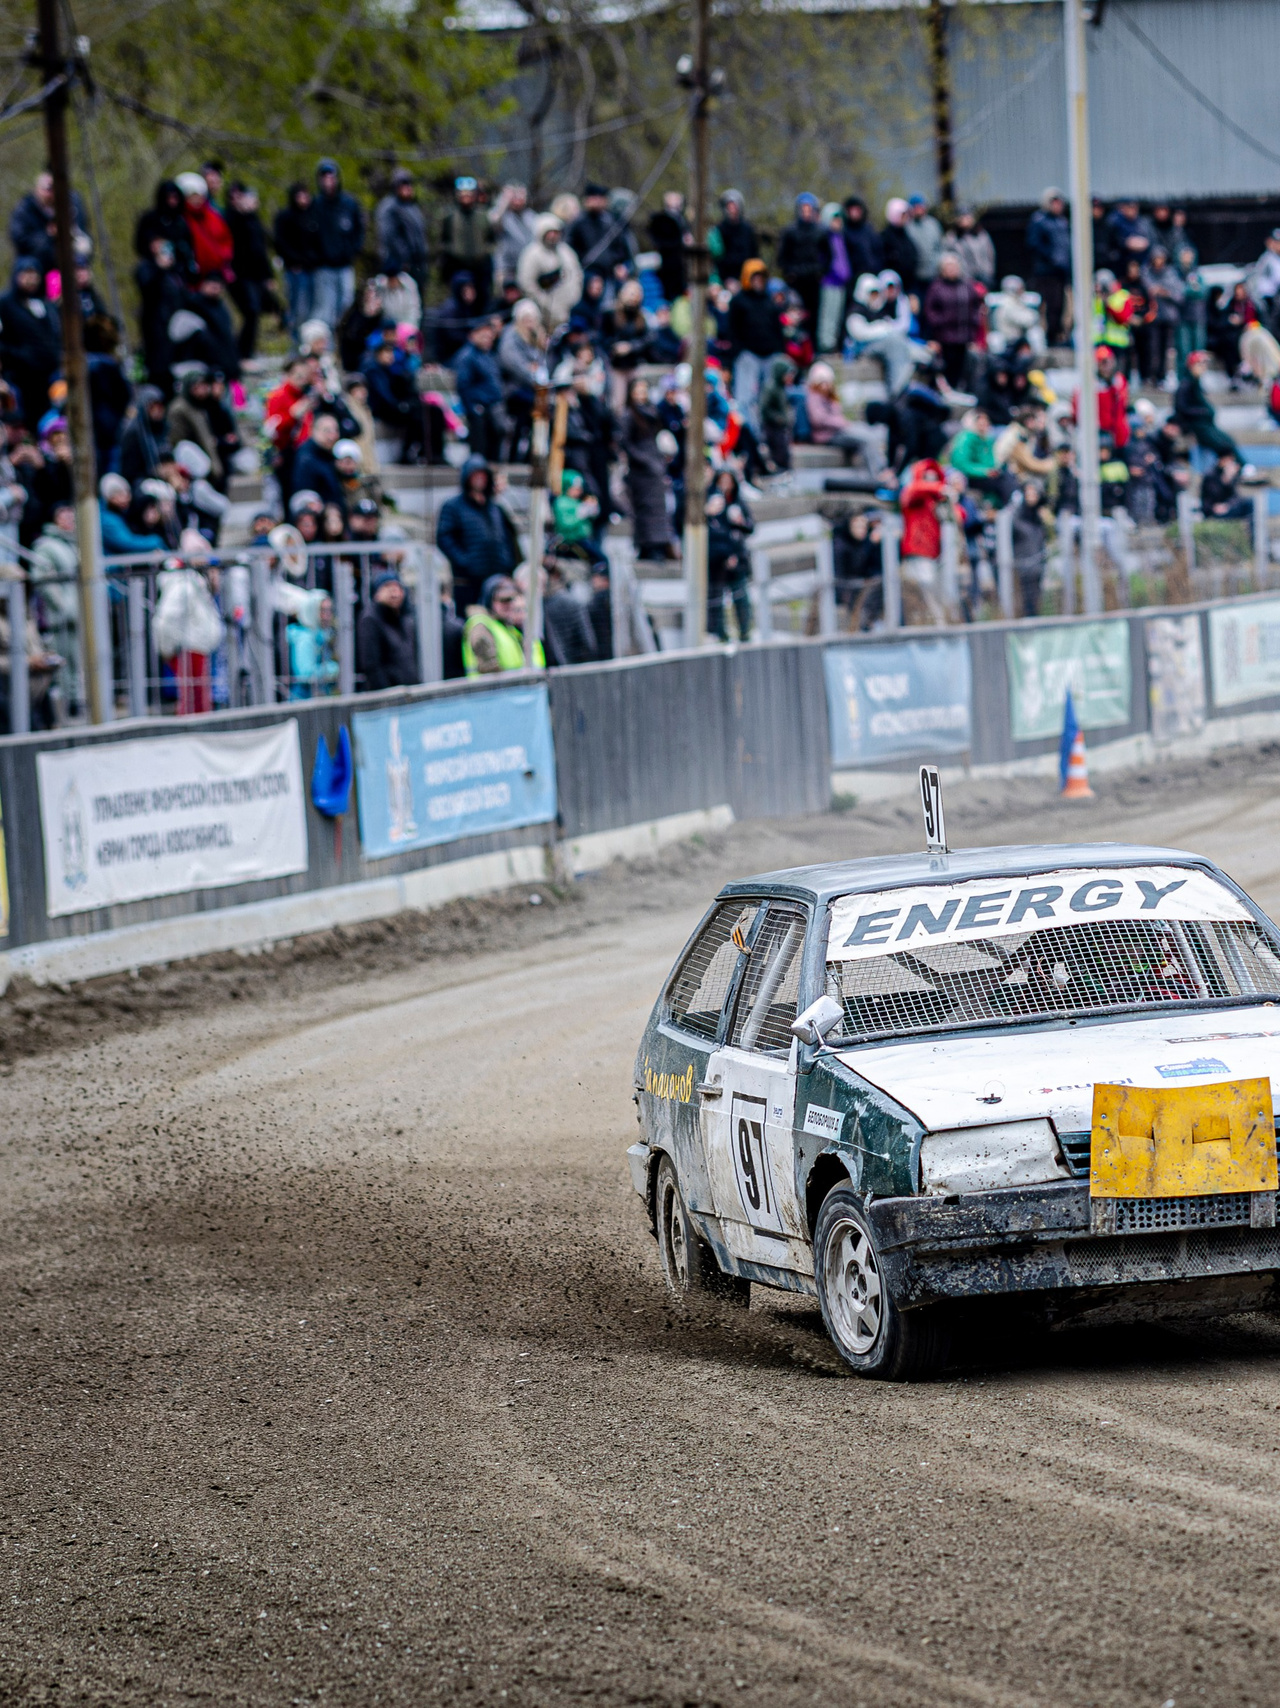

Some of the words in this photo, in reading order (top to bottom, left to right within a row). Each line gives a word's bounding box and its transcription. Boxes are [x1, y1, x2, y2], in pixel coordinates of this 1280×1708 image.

[921, 768, 941, 843] 97
[842, 879, 1188, 947] ENERGY
[1056, 1077, 1134, 1091] euol
[738, 1118, 771, 1214] 97
